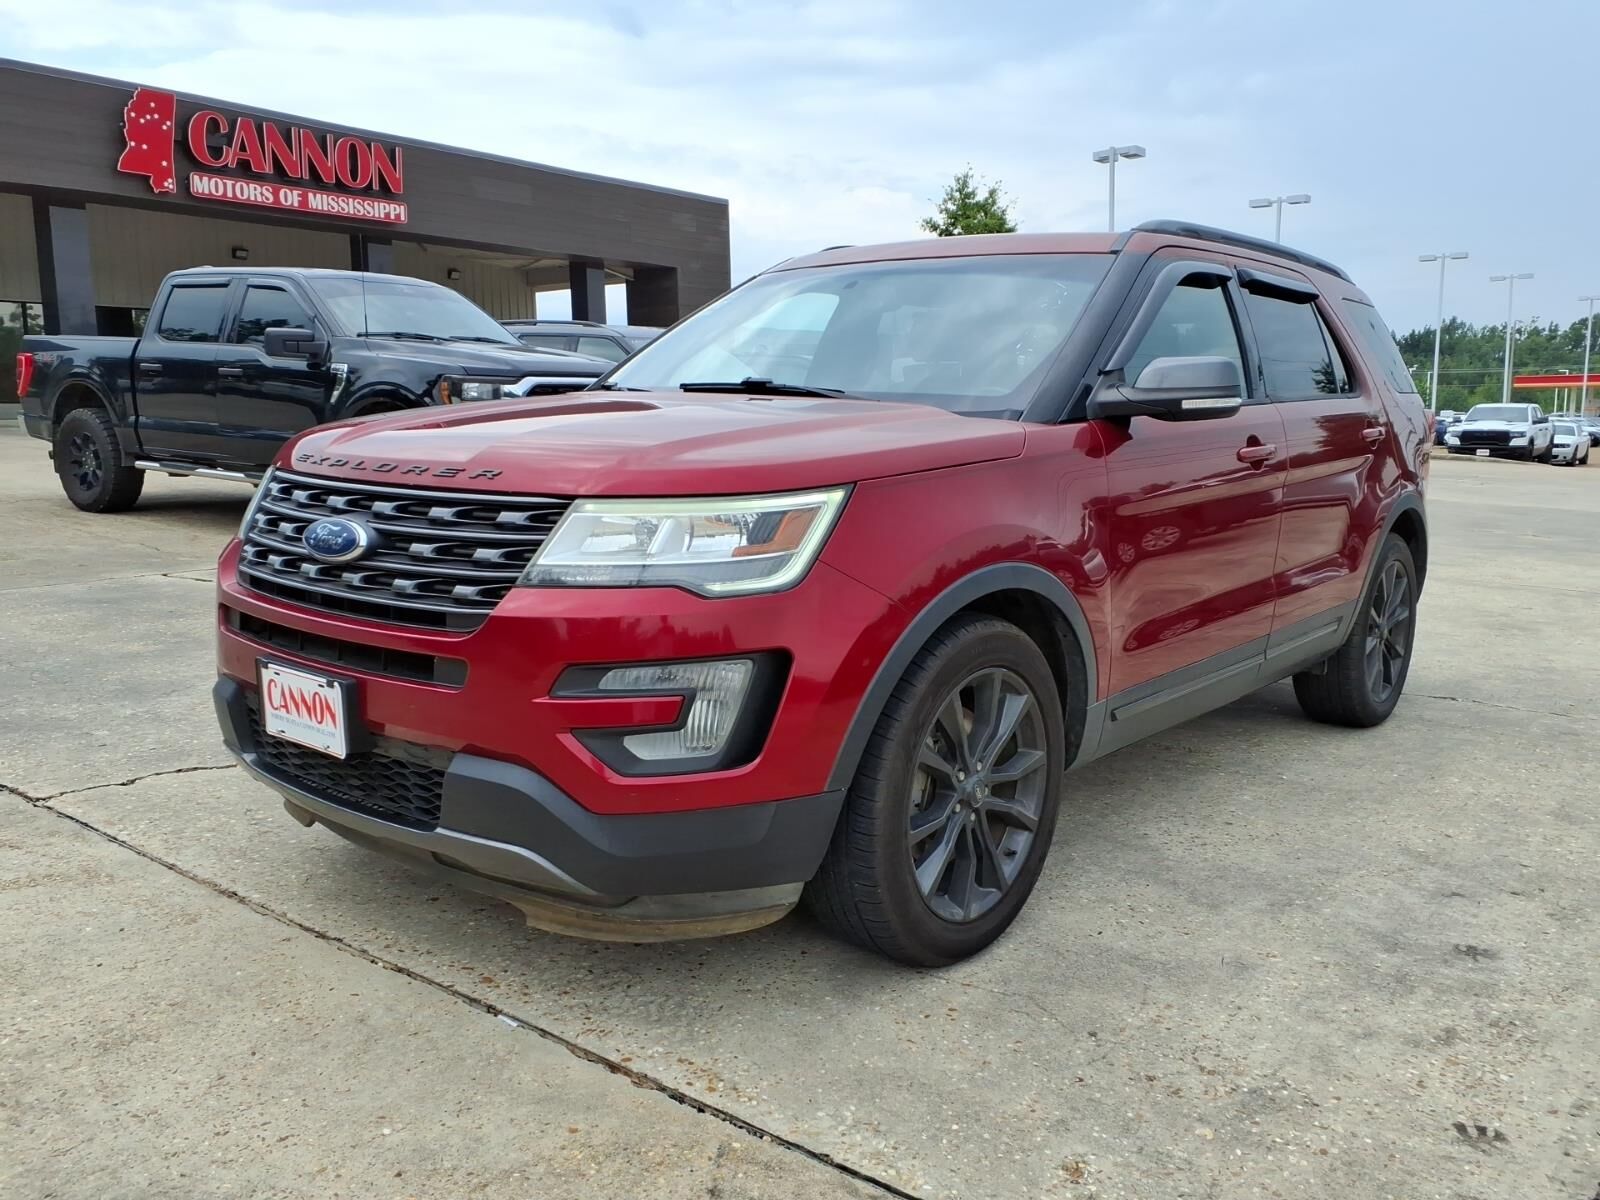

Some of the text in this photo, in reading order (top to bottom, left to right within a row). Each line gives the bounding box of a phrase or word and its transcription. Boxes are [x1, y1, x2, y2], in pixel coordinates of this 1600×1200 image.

[188, 110, 403, 194] CANNON
[193, 174, 406, 222] MOTORS OF MISSISSIPPI
[296, 453, 503, 480] EXPLORER
[310, 523, 348, 549] Ford
[267, 678, 338, 731] CANNON
